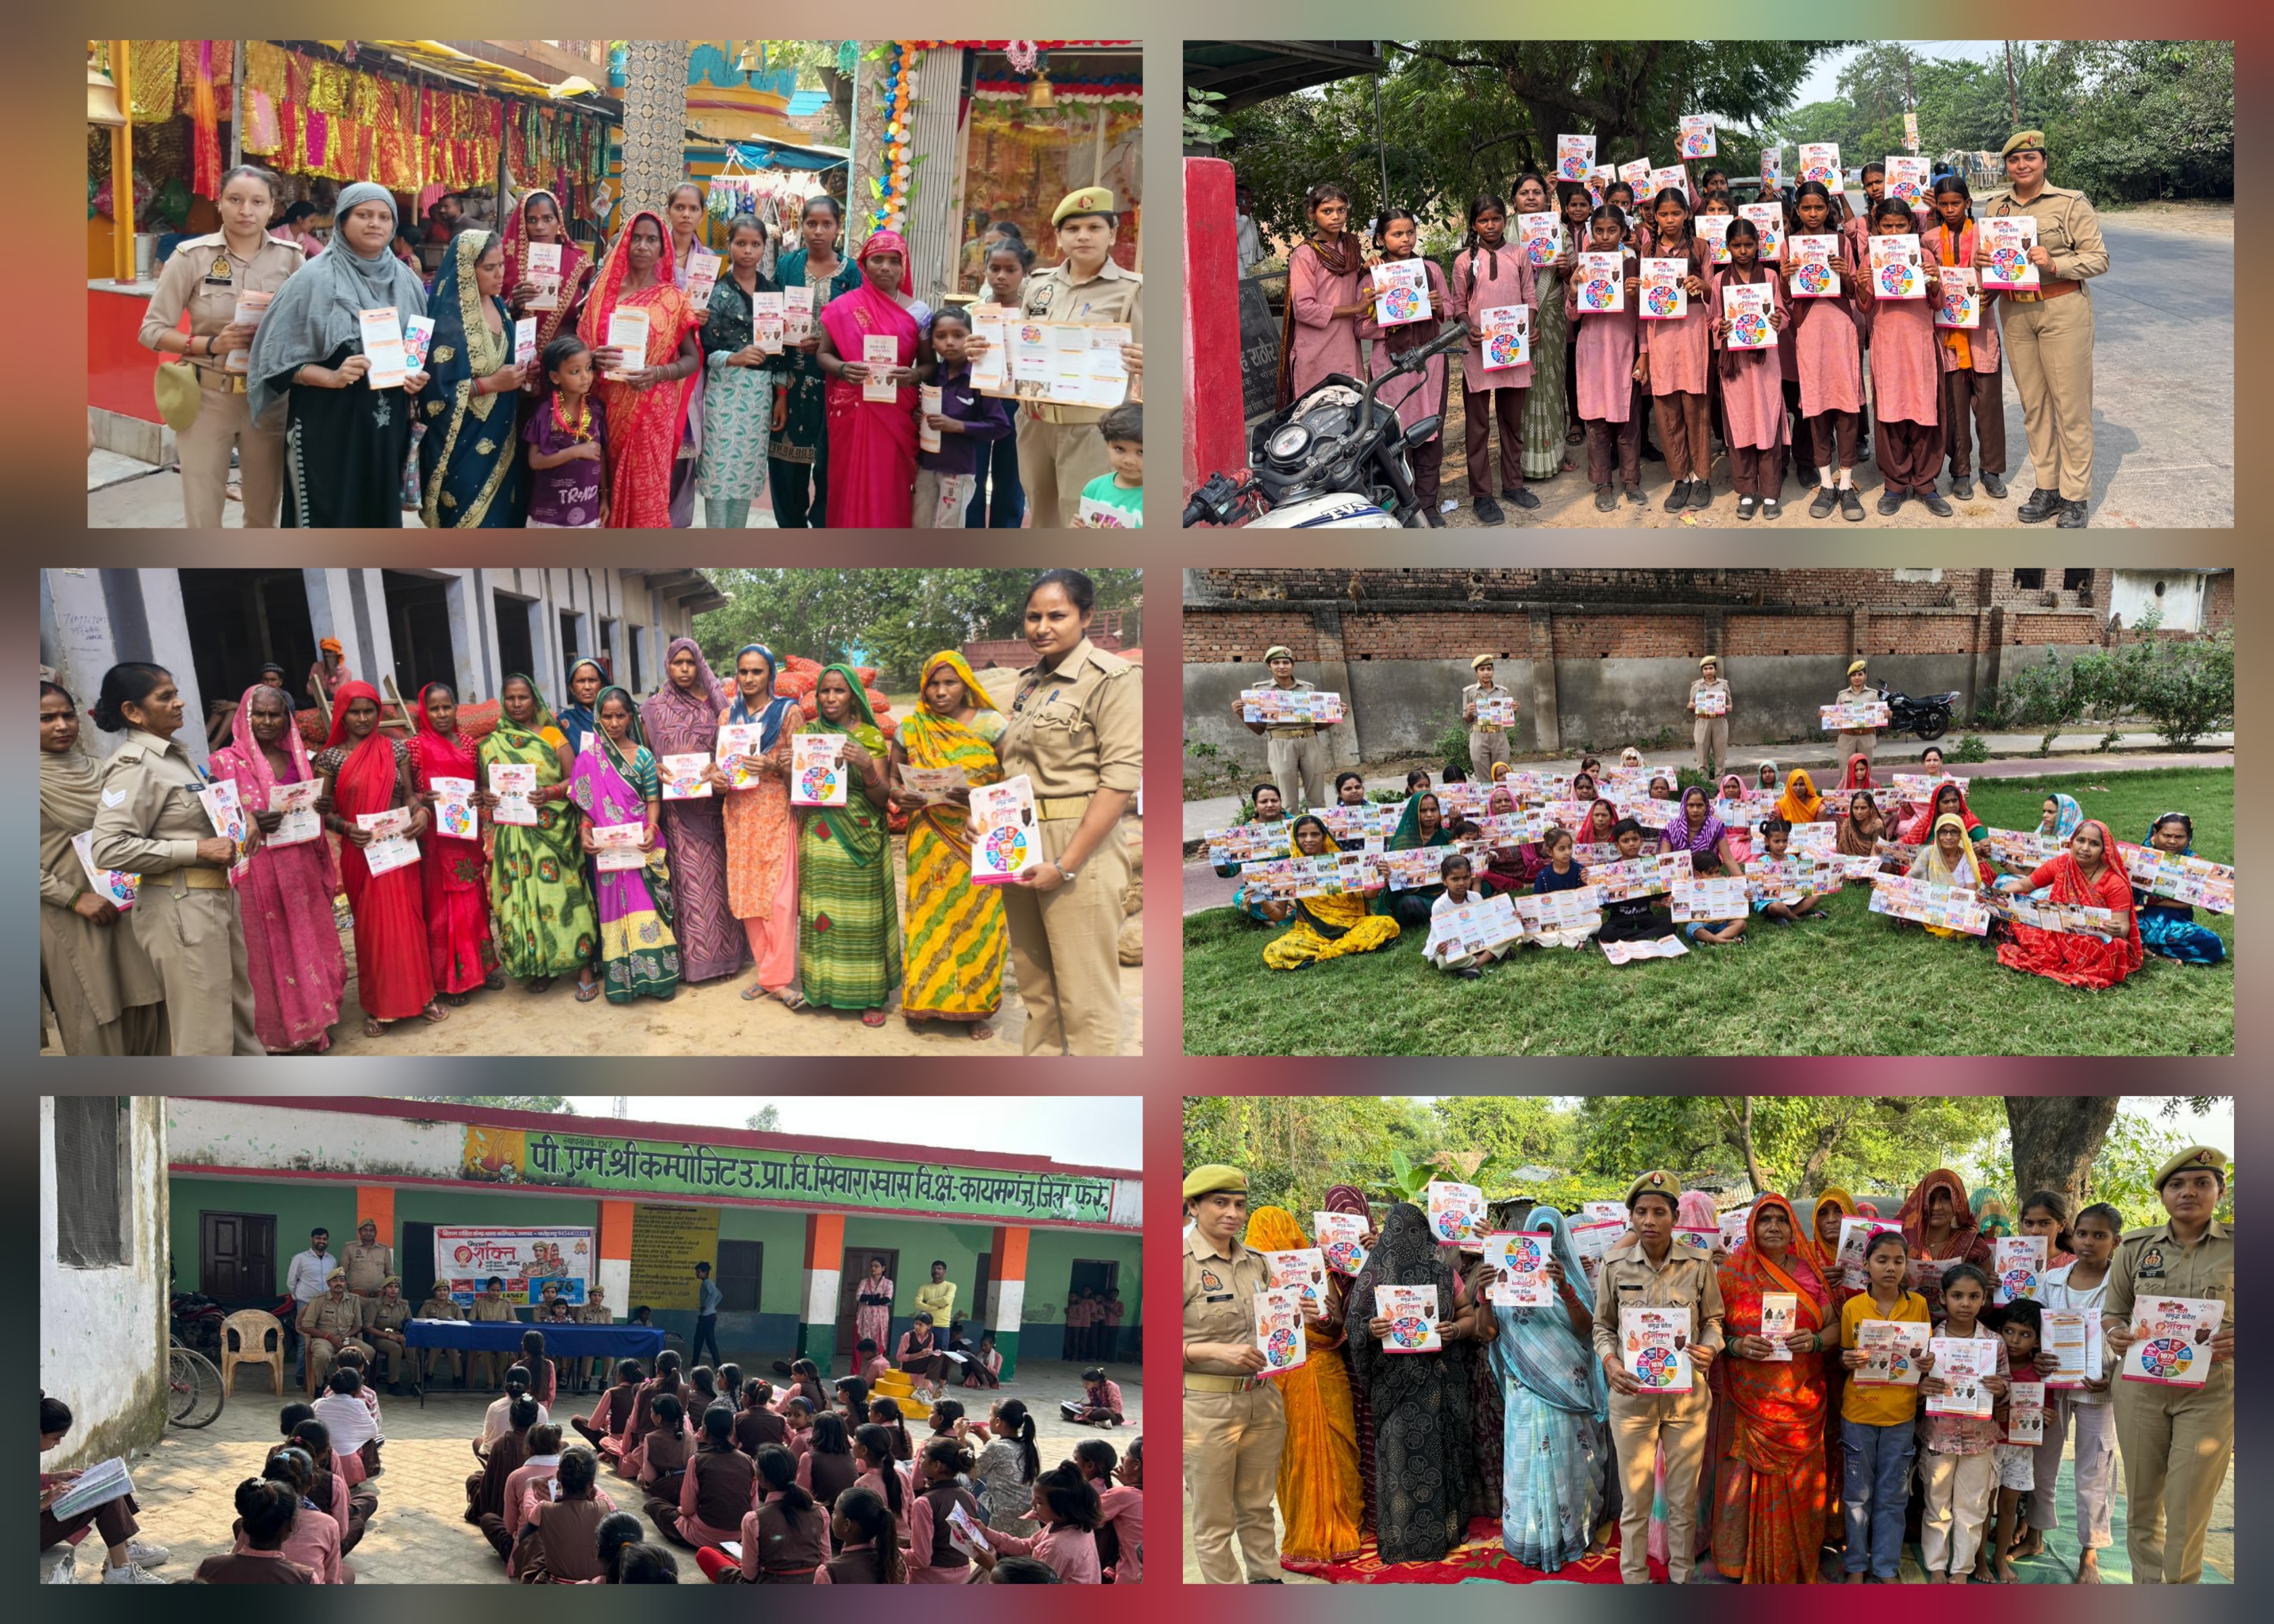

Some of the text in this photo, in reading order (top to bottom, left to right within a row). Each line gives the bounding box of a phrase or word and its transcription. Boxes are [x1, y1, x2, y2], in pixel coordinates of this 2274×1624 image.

[1320, 501, 1369, 520] TVS
[640, 1143, 738, 1186] कम्पोजिट
[871, 1169, 916, 1204] खास
[473, 1240, 517, 1269] शक्ति
